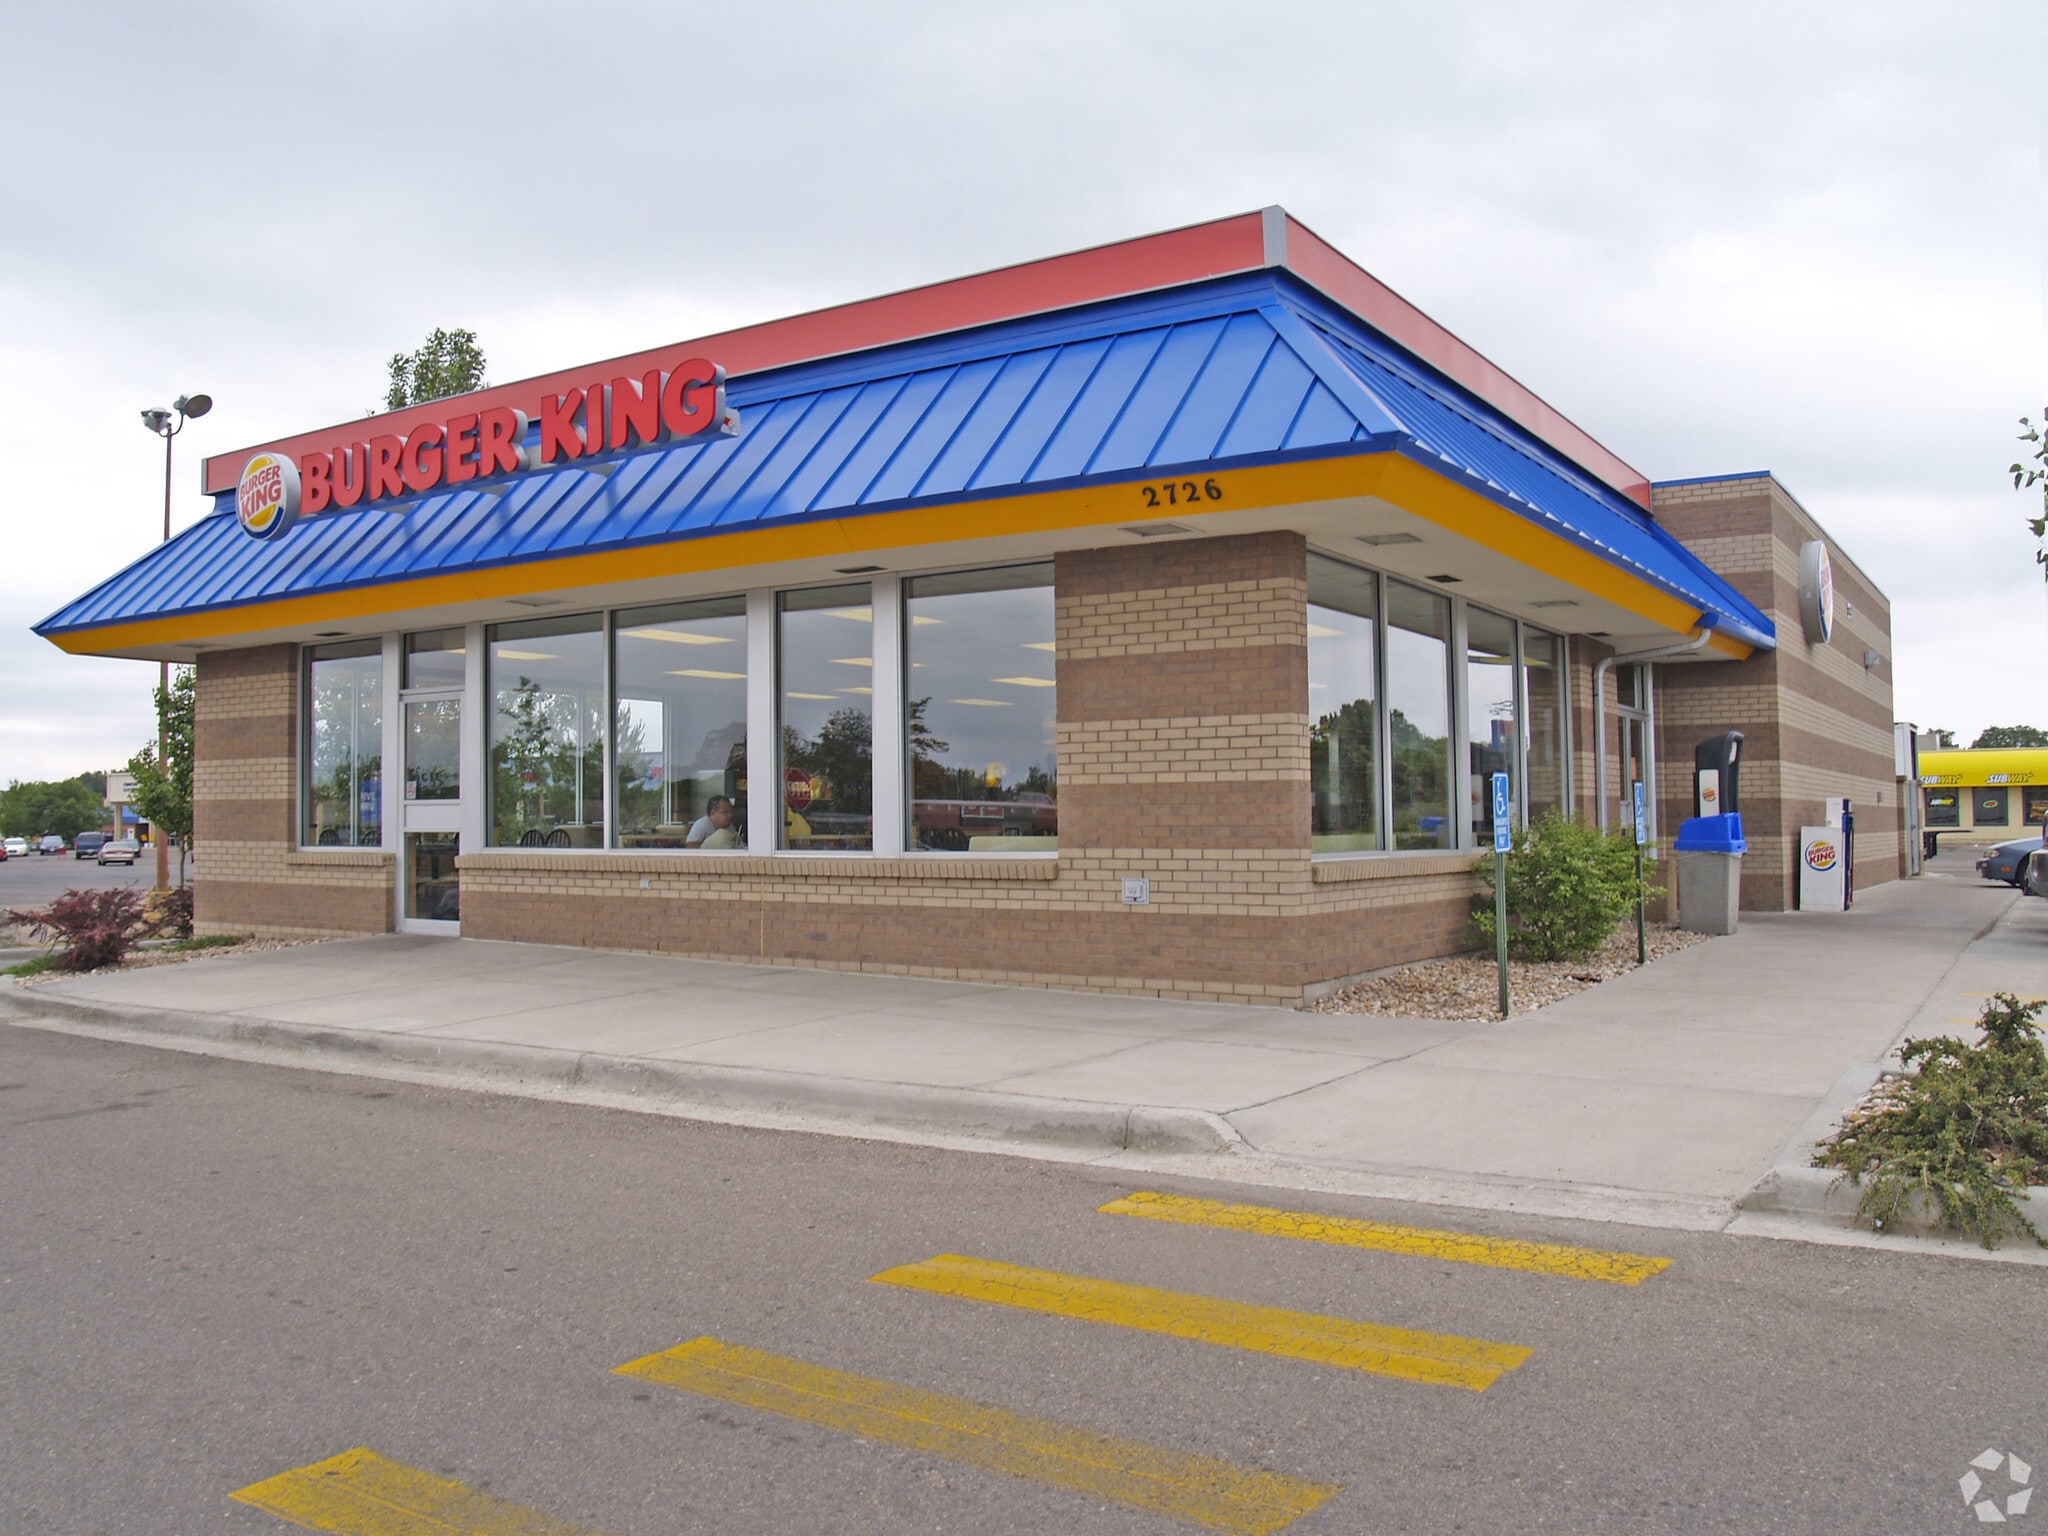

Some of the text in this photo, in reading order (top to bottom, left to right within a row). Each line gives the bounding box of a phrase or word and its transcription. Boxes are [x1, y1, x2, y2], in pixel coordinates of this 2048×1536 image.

[301, 358, 718, 515] BURGER KING
[240, 465, 281, 501] BURGER
[1142, 478, 1222, 507] 2726
[241, 480, 282, 524] KING
[1986, 772, 2034, 784] SUBWAY
[1808, 845, 1834, 857] BURGER
[1810, 851, 1836, 865] KING
